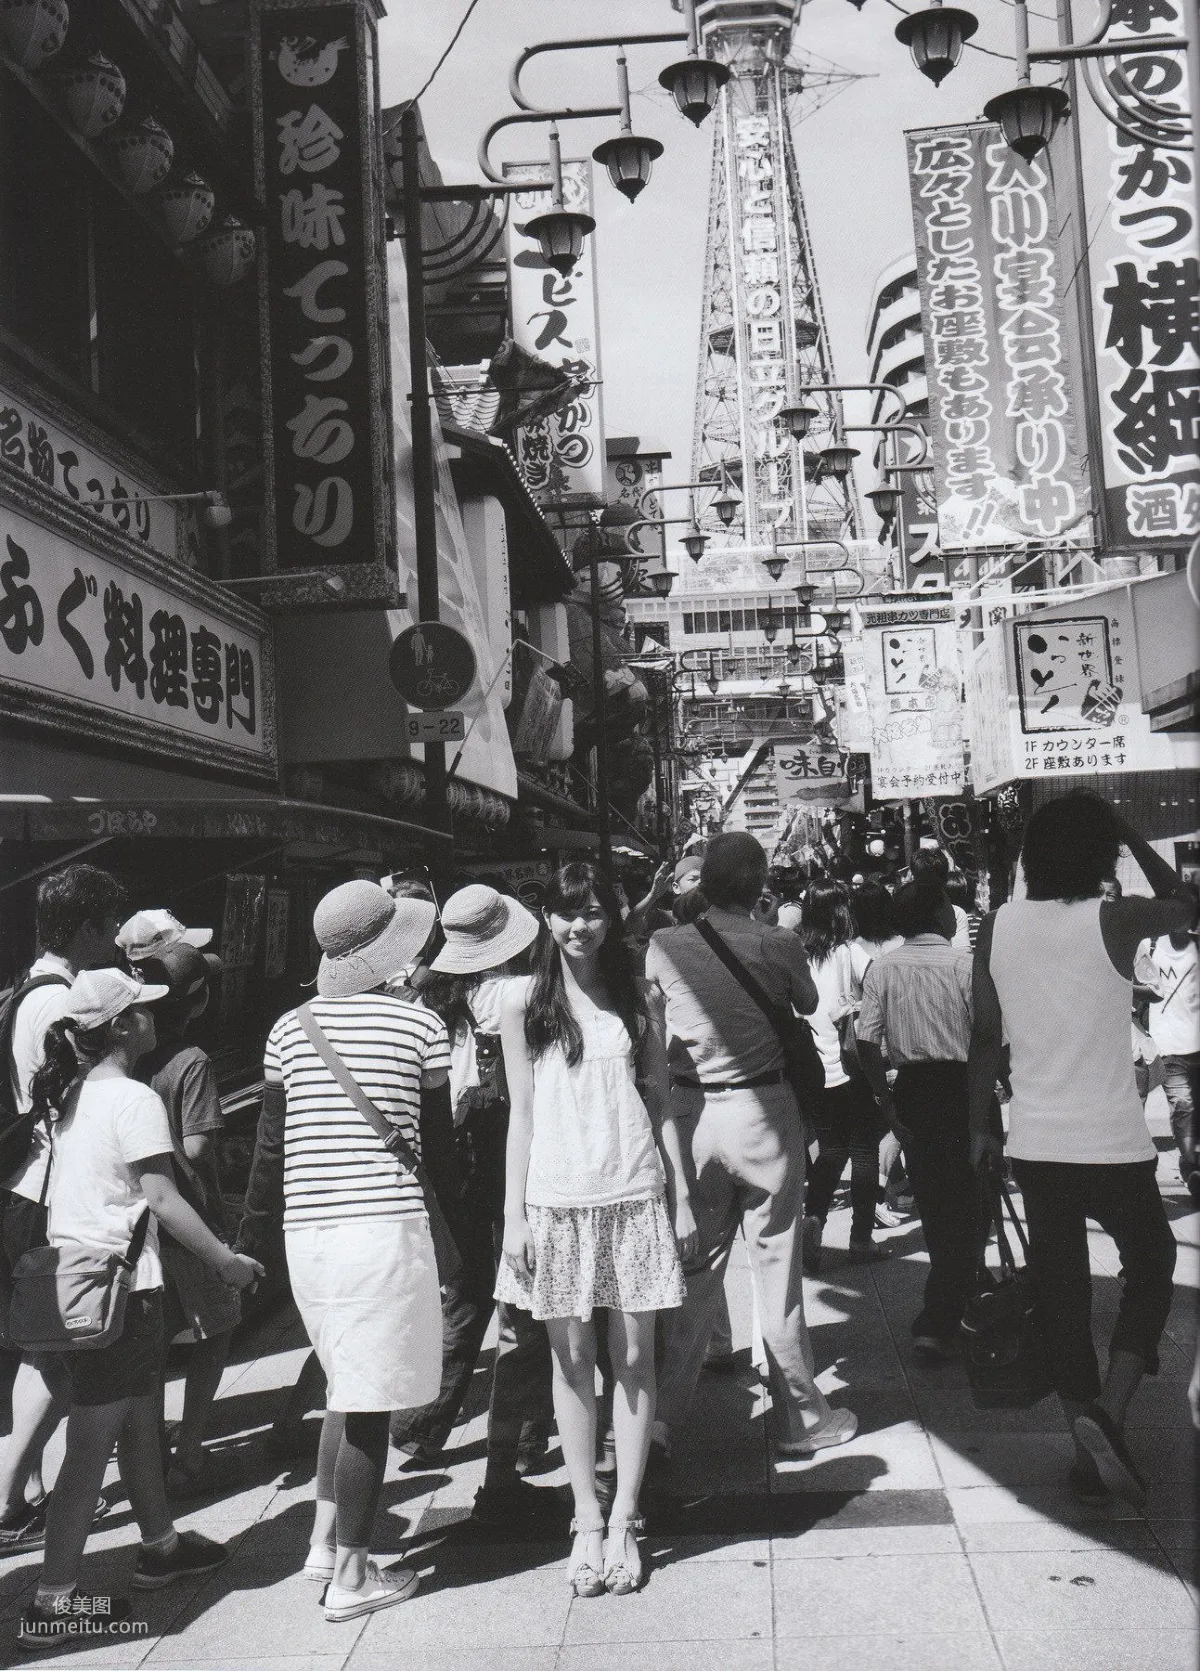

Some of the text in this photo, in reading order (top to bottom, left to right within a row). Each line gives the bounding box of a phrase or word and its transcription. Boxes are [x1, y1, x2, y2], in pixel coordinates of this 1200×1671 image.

[409, 718, 460, 736] 9-22
[1025, 735, 1126, 752] 1F カウンター席
[1025, 753, 1127, 770] 2F 座敷あります
[877, 771, 962, 789] 宴会予約受付中
